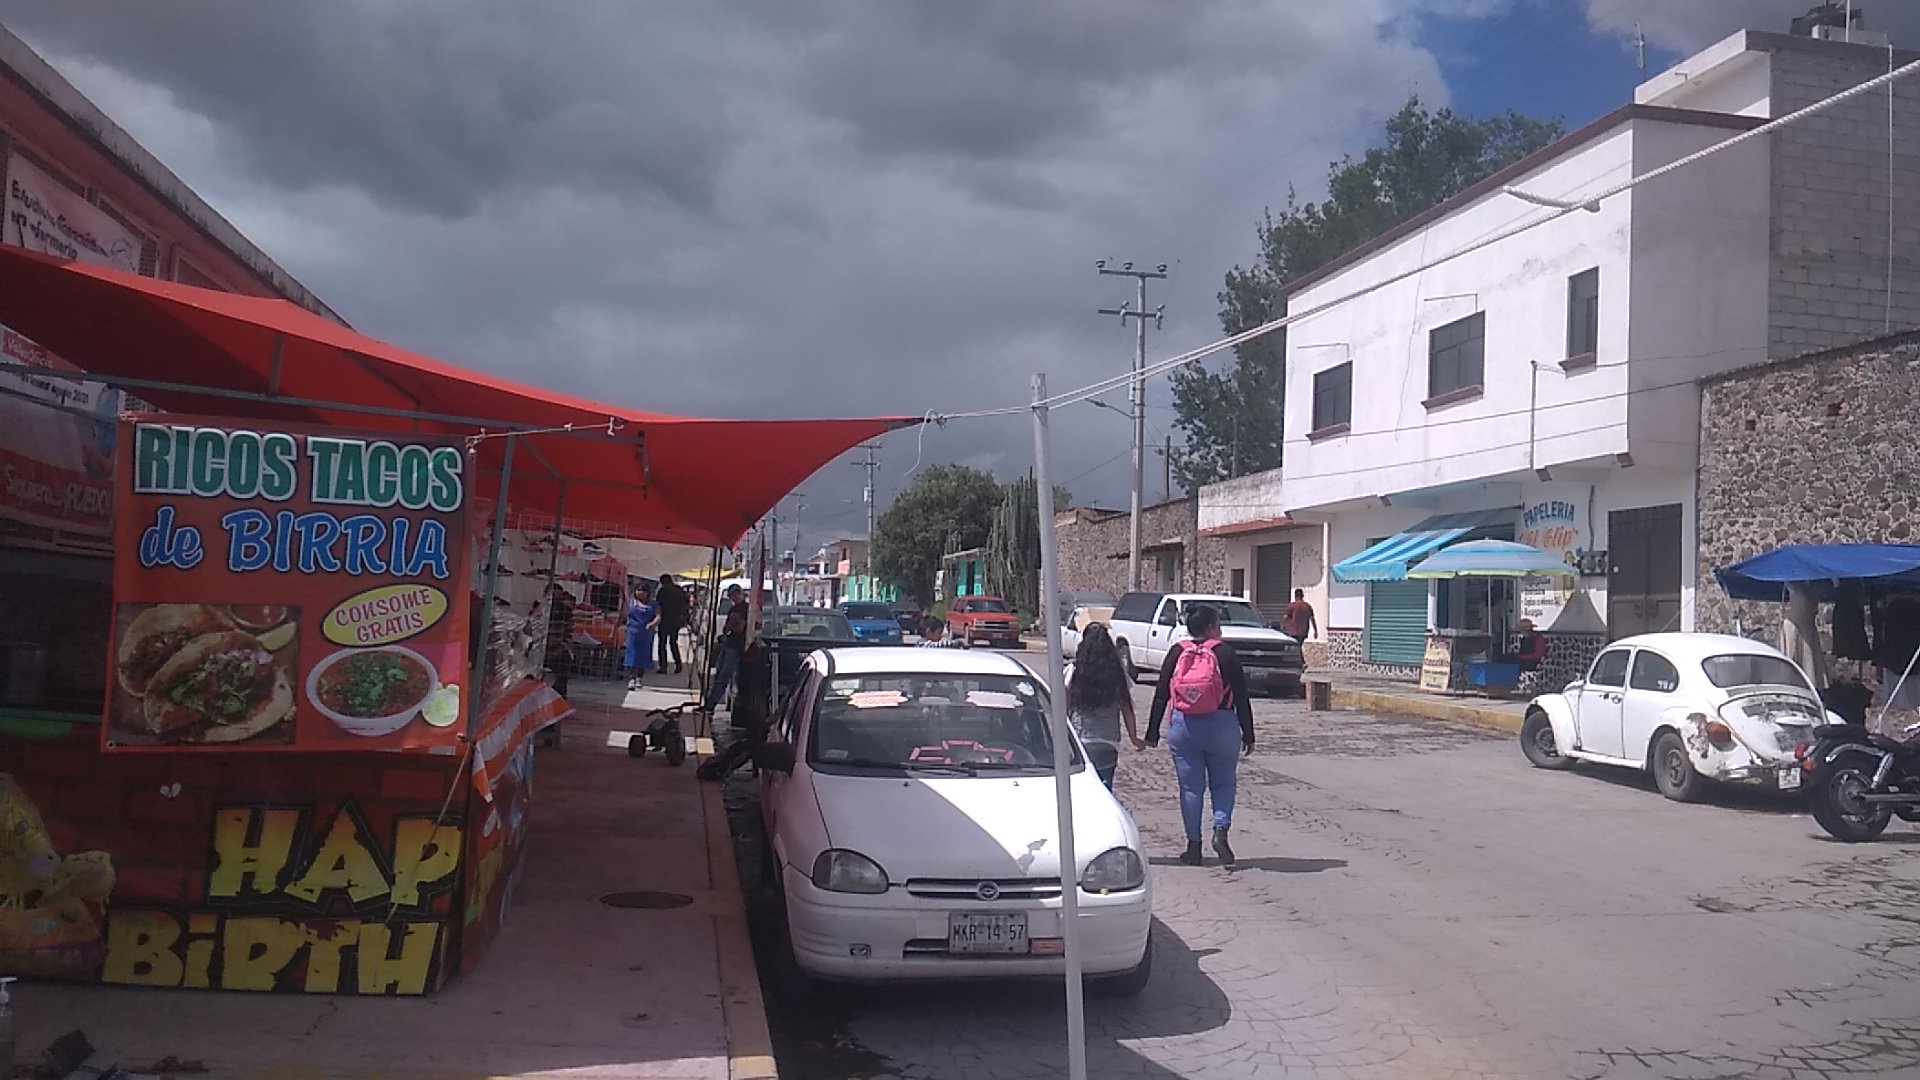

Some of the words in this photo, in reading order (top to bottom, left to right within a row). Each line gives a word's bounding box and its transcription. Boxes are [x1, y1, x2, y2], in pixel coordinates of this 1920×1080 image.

[134, 423, 297, 501] RICOS
[306, 435, 464, 512] TACOS
[1523, 501, 1575, 528] PAPELERIA
[140, 506, 203, 569] de
[221, 508, 450, 580] BIRRIA
[335, 588, 432, 627] CONSOME
[356, 611, 424, 643] GRATIS
